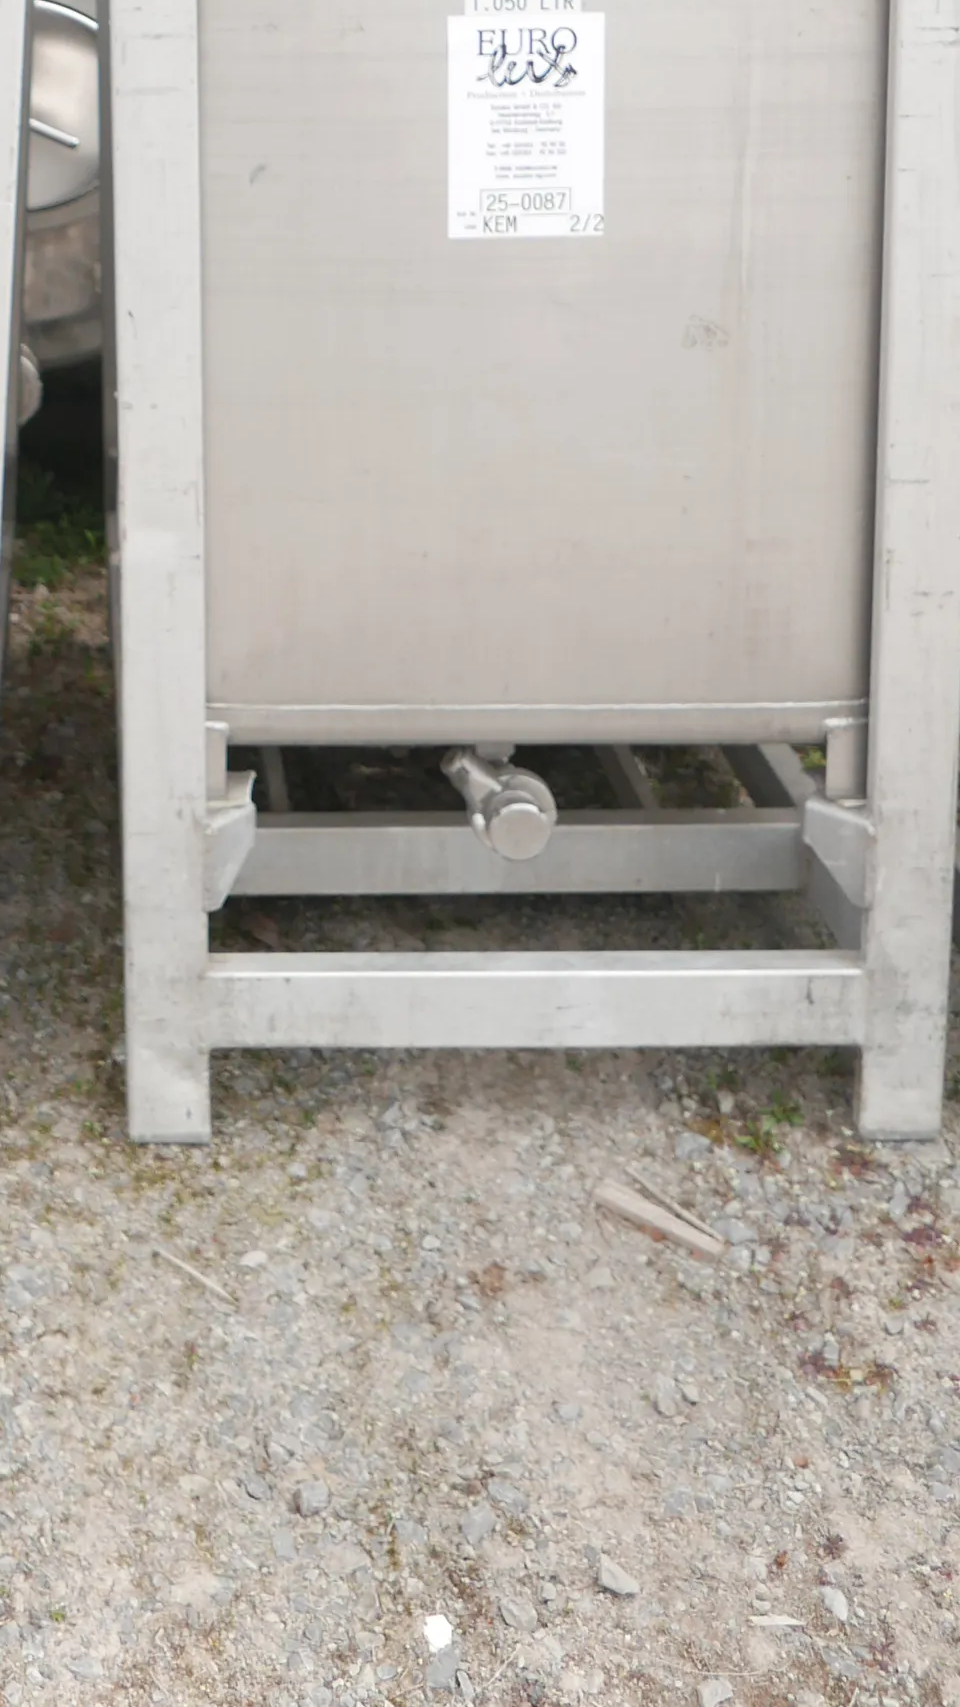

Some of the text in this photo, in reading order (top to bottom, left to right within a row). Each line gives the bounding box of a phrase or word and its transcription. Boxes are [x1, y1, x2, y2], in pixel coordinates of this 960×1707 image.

[477, 26, 578, 56] EURO
[485, 191, 567, 212] 25-0087
[482, 215, 518, 234] KEM
[569, 213, 606, 233] 2/2
